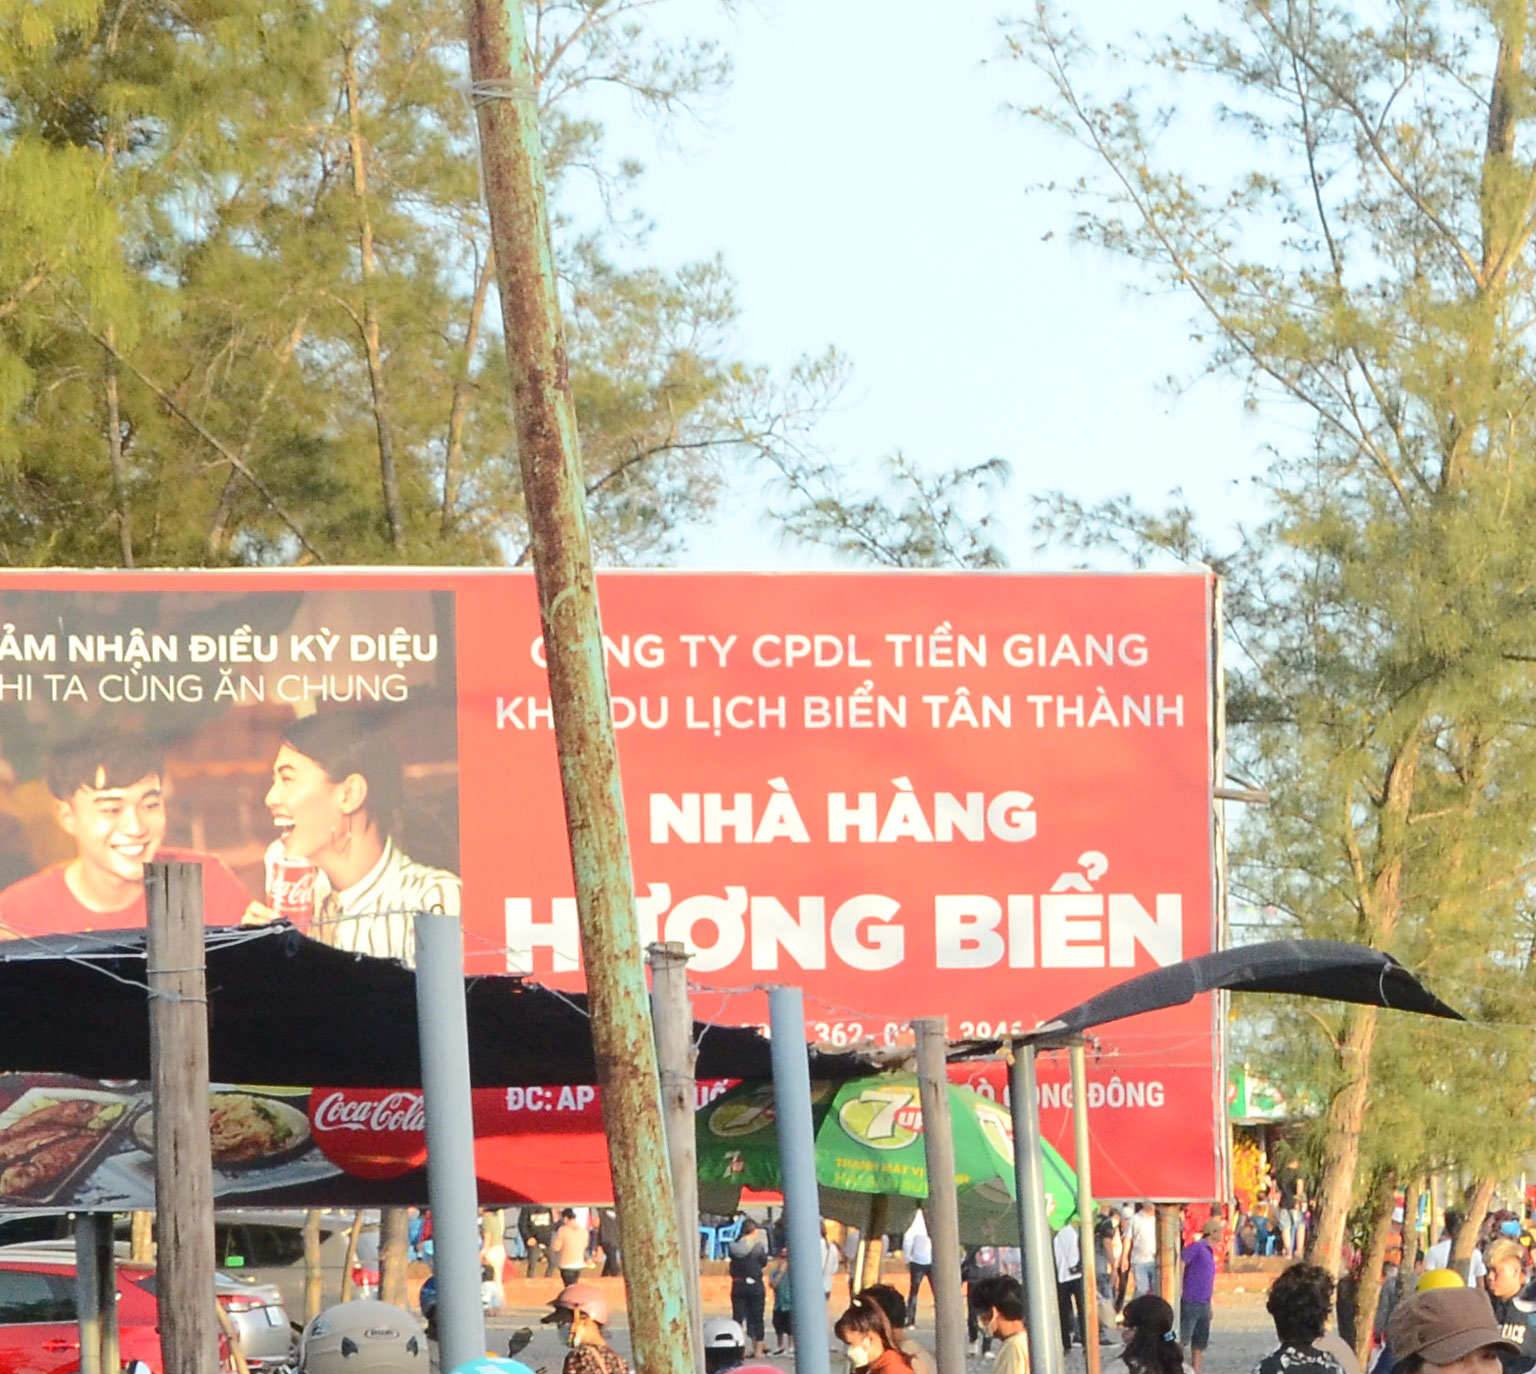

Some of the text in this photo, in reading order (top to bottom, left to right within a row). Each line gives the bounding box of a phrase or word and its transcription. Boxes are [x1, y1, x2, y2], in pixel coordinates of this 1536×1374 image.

[0, 623, 437, 669] ẢM NHẬN ĐIỀU KỲ DIỆU
[530, 621, 1149, 668] CNG TY CPDL TIỀN GIANG
[0, 668, 409, 702] HI TA CÙNG ĂN CHUNG
[496, 680, 1184, 737] KH DU LỊCH BIỂN TÂN THÀNH
[649, 776, 1038, 844] NHÀ HÀNG
[505, 850, 1182, 973] HƠNG BIỂN
[1088, 1076, 1165, 1108] ĐÔNG
